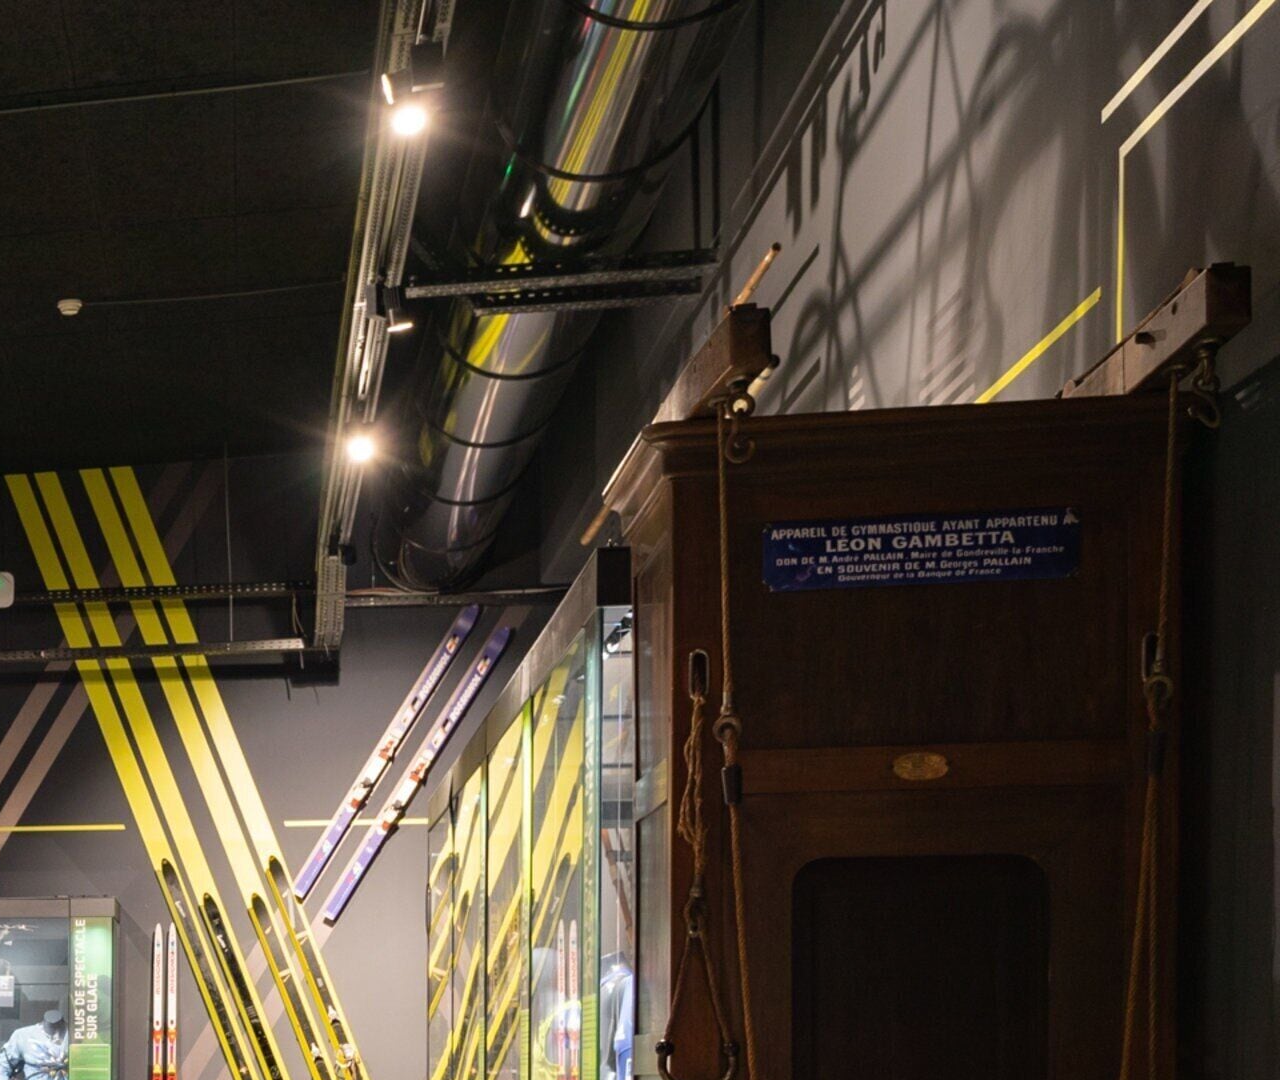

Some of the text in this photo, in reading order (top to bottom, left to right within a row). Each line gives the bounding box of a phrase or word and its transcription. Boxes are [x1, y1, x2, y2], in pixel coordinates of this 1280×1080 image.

[770, 527, 828, 541] APPAREIL
[831, 526, 848, 538] DE
[851, 521, 937, 536] GYMNASTIQUE
[942, 518, 981, 531] AYANT
[986, 515, 1058, 530] APPARTENU
[891, 530, 1016, 549] GAMBETTA
[776, 557, 798, 567] DON
[801, 556, 815, 565] DE
[816, 566, 833, 575] EN
[837, 562, 900, 574] SOUVENIR
[904, 561, 921, 571] DE
[940, 559, 979, 570] Georges
[983, 556, 1033, 567] PALLAIN
[74, 919, 87, 1040] PLUS DE SPECTACLE
[86, 973, 98, 1040] SUR GLACE
